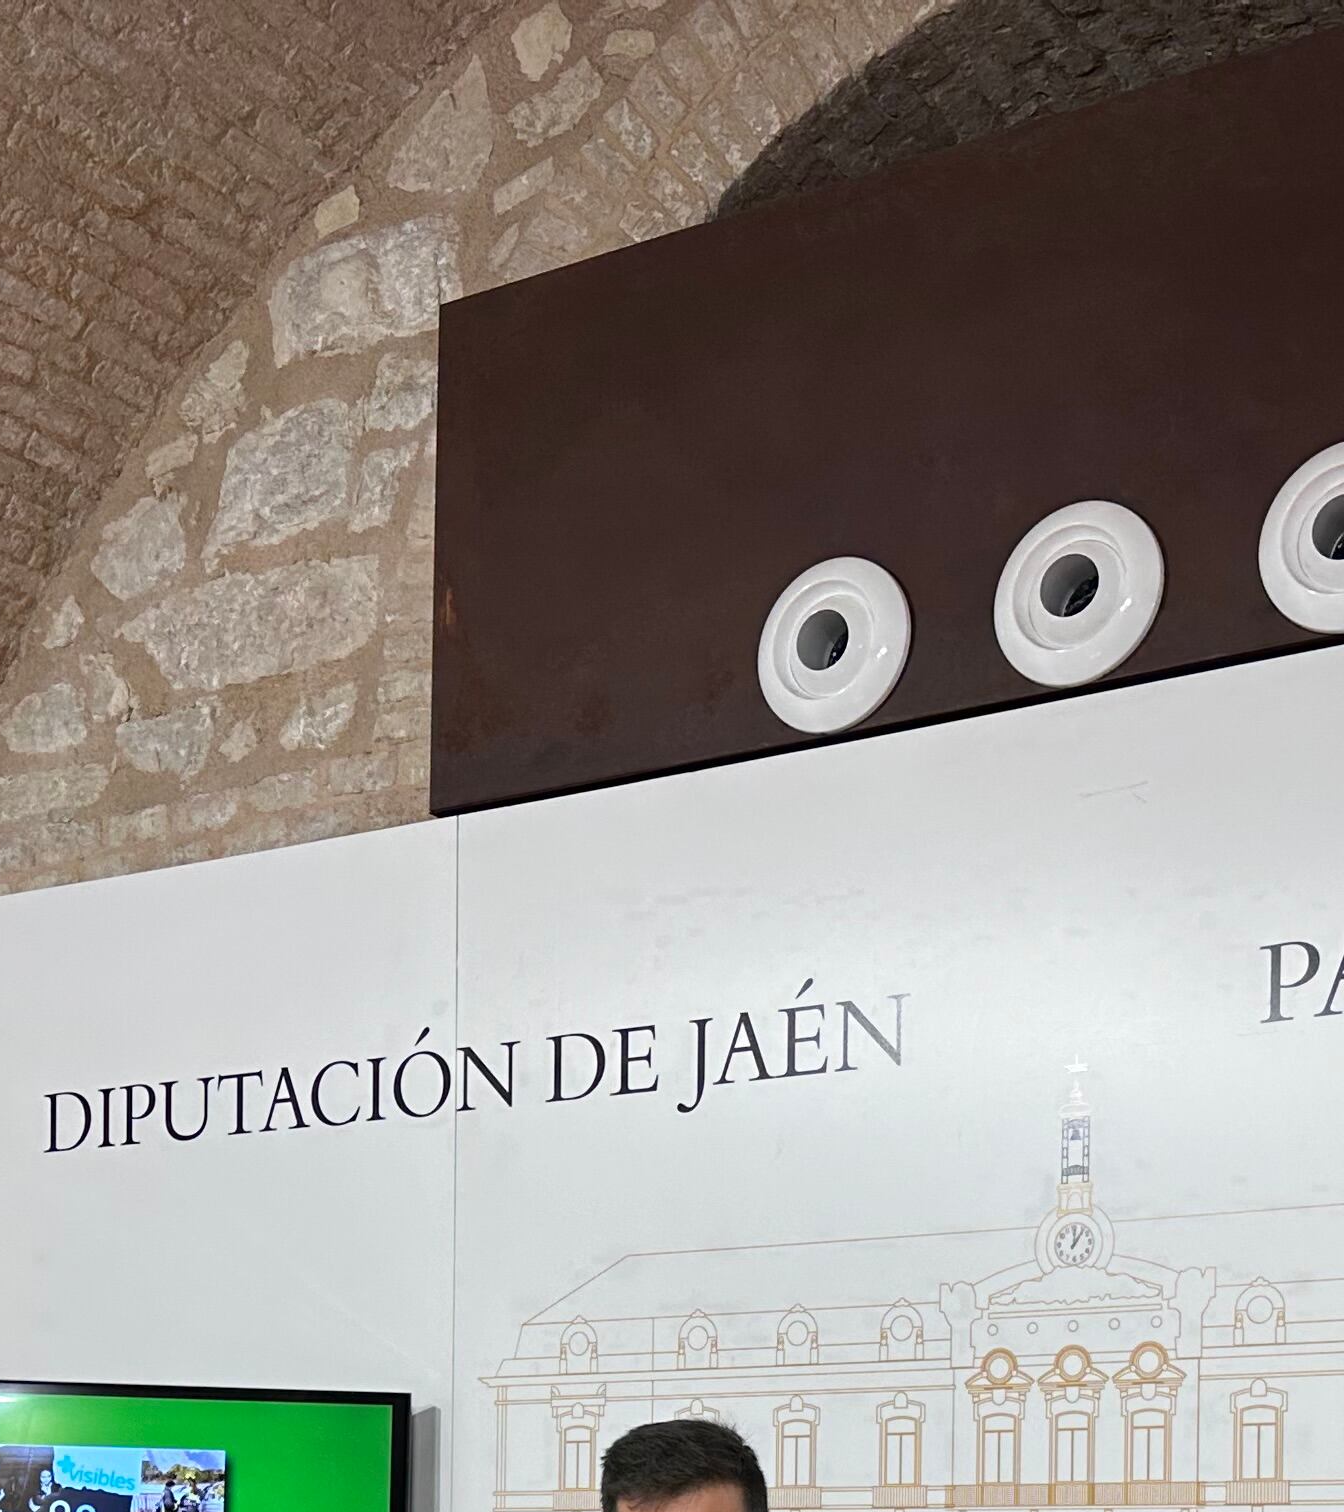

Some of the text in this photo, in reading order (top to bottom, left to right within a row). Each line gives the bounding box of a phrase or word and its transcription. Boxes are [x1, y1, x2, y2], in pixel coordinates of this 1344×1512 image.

[43, 978, 911, 1153] DIPUTACIÓN DE JAÉN
